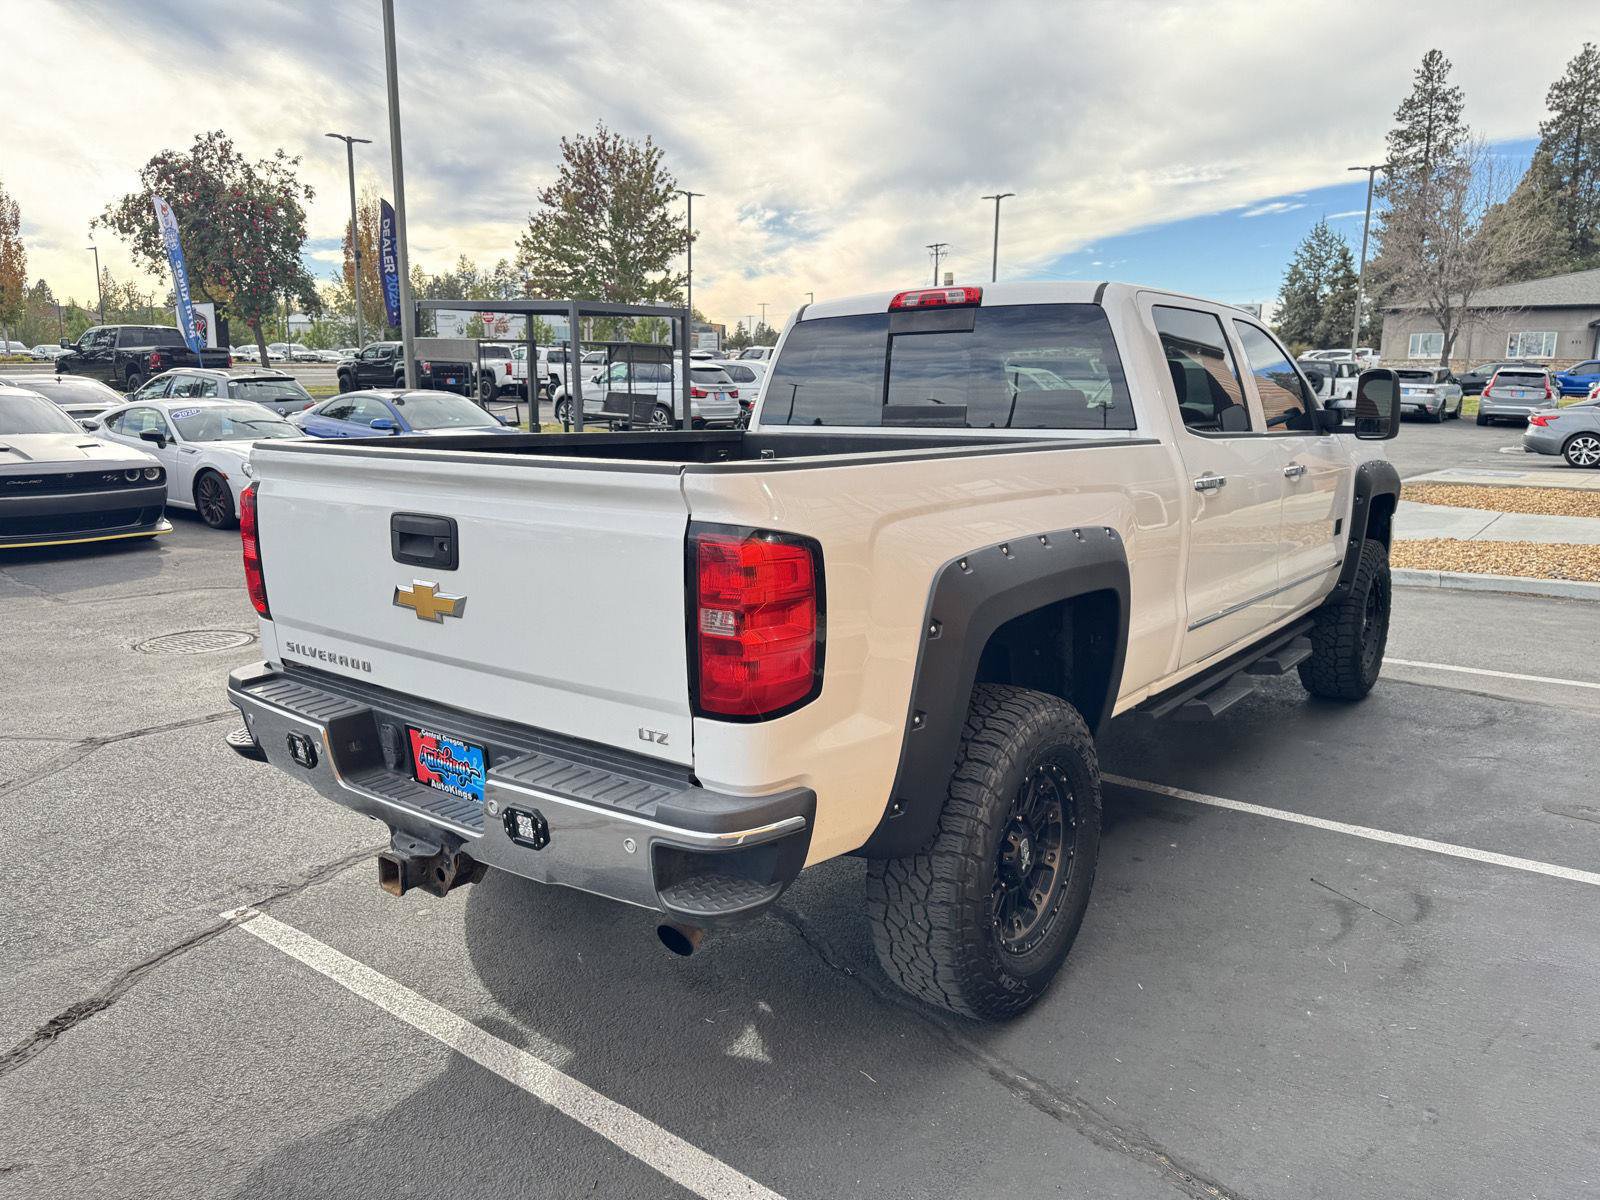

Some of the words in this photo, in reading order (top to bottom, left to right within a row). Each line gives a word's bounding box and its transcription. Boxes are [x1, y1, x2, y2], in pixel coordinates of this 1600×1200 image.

[382, 218, 395, 274] DEALER
[286, 641, 371, 673] SILVERADO
[421, 729, 441, 741] Central
[442, 735, 464, 747] Oregon
[638, 727, 669, 746] LTZ
[431, 779, 473, 801] AutoKings
